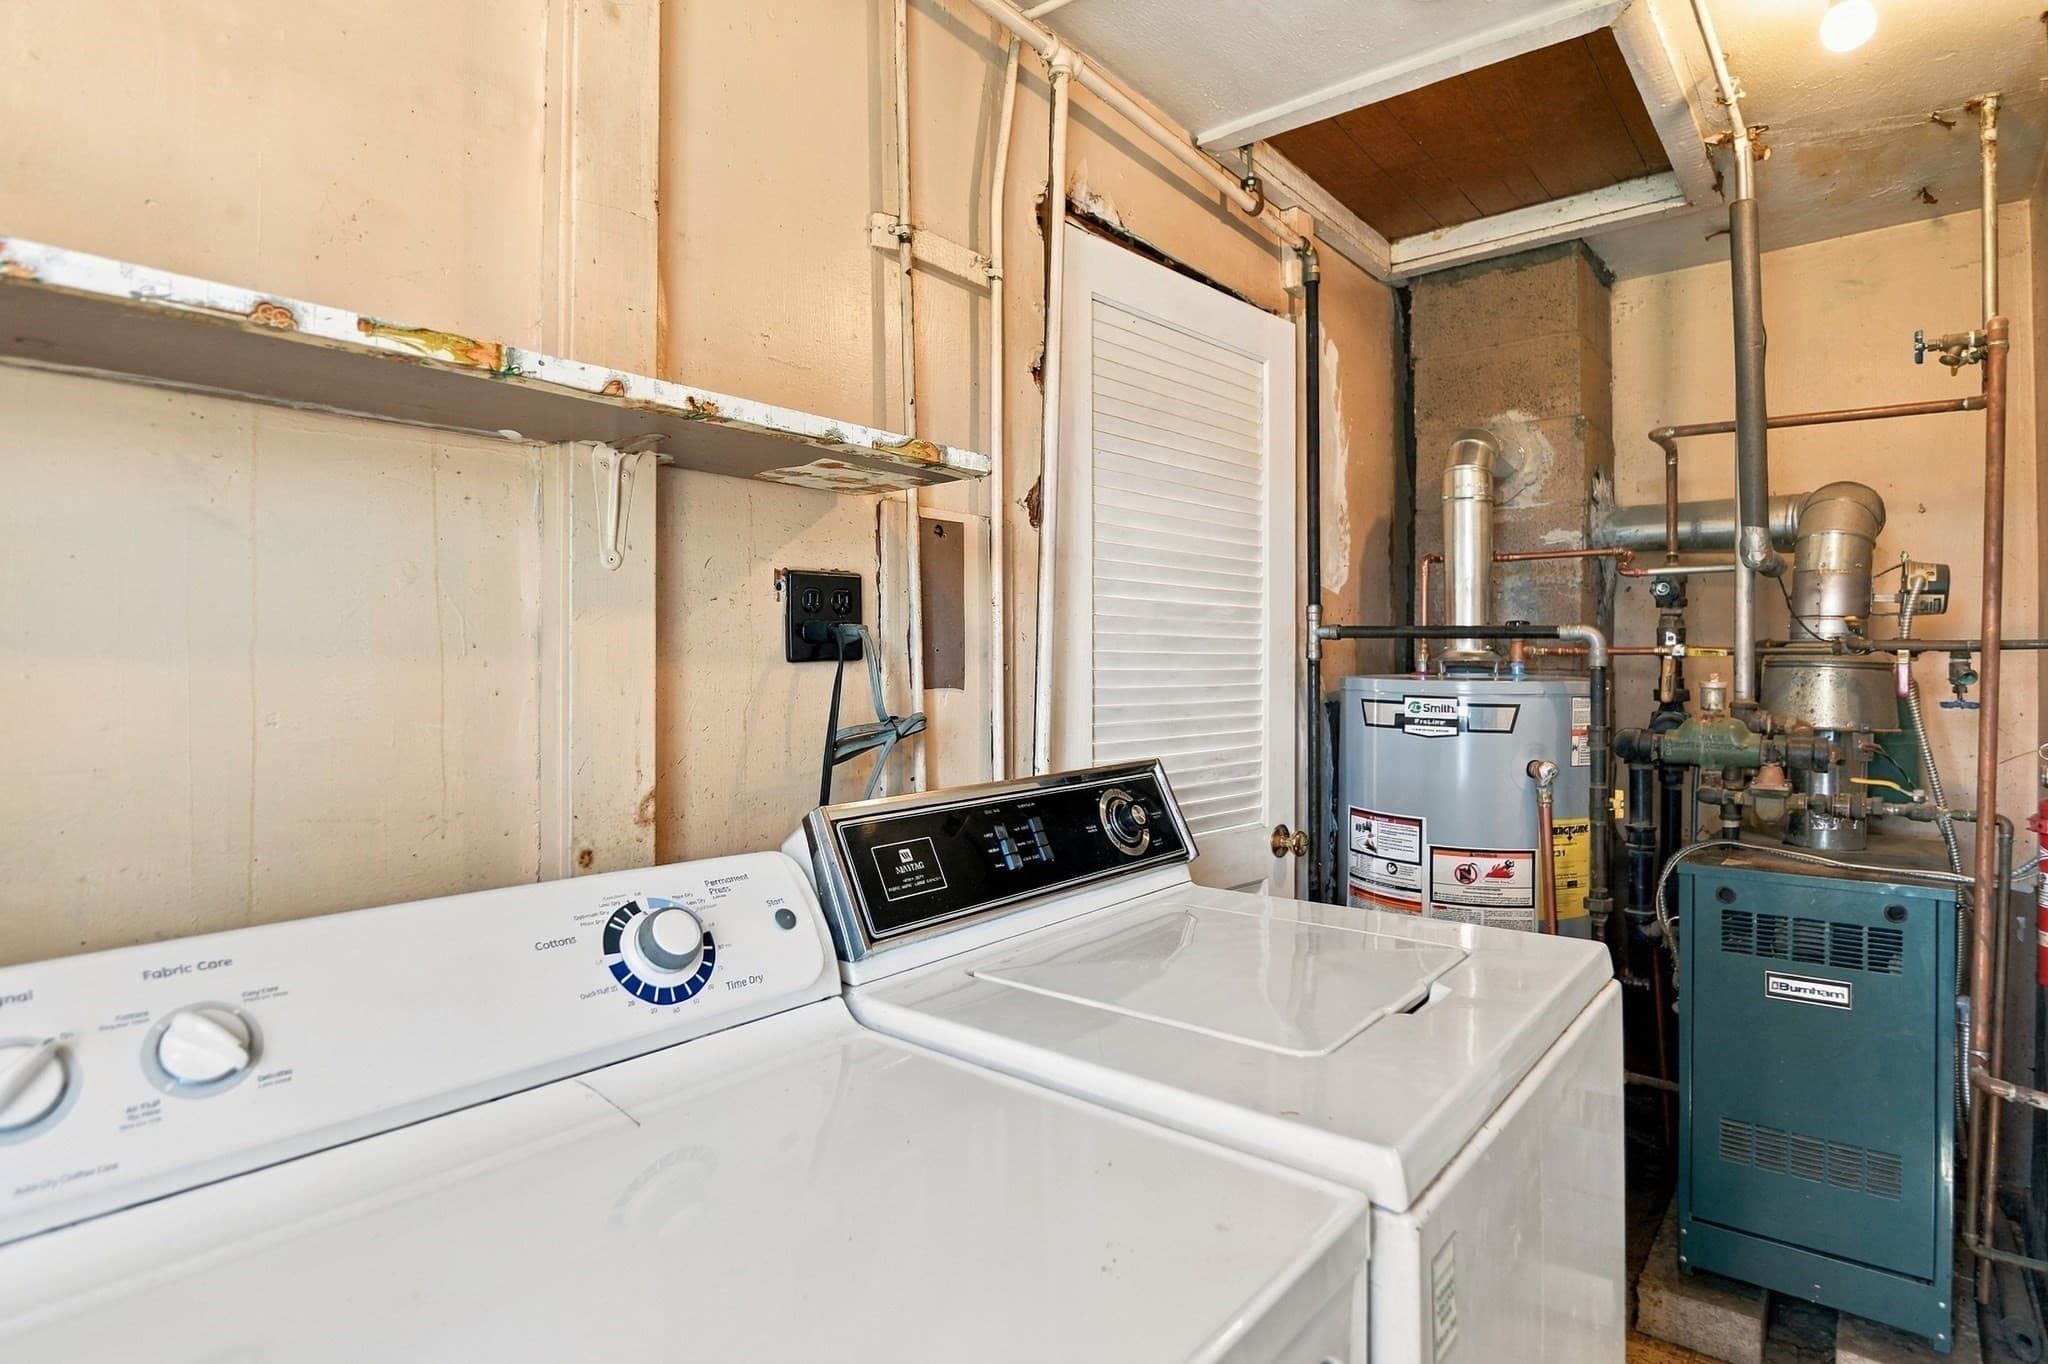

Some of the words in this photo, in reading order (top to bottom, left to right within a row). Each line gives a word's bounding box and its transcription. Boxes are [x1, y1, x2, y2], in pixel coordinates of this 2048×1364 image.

[1423, 703, 1455, 713] Smith
[895, 861, 925, 875] MAYTAG
[704, 873, 750, 888] Permanent
[709, 886, 731, 895] Press
[766, 897, 785, 908] Start
[535, 936, 577, 951] Cottons
[142, 965, 192, 982] Fabric
[196, 957, 233, 971] Care
[726, 980, 748, 992] Time
[748, 975, 764, 985] Dry
[1780, 981, 1845, 999] Burnham
